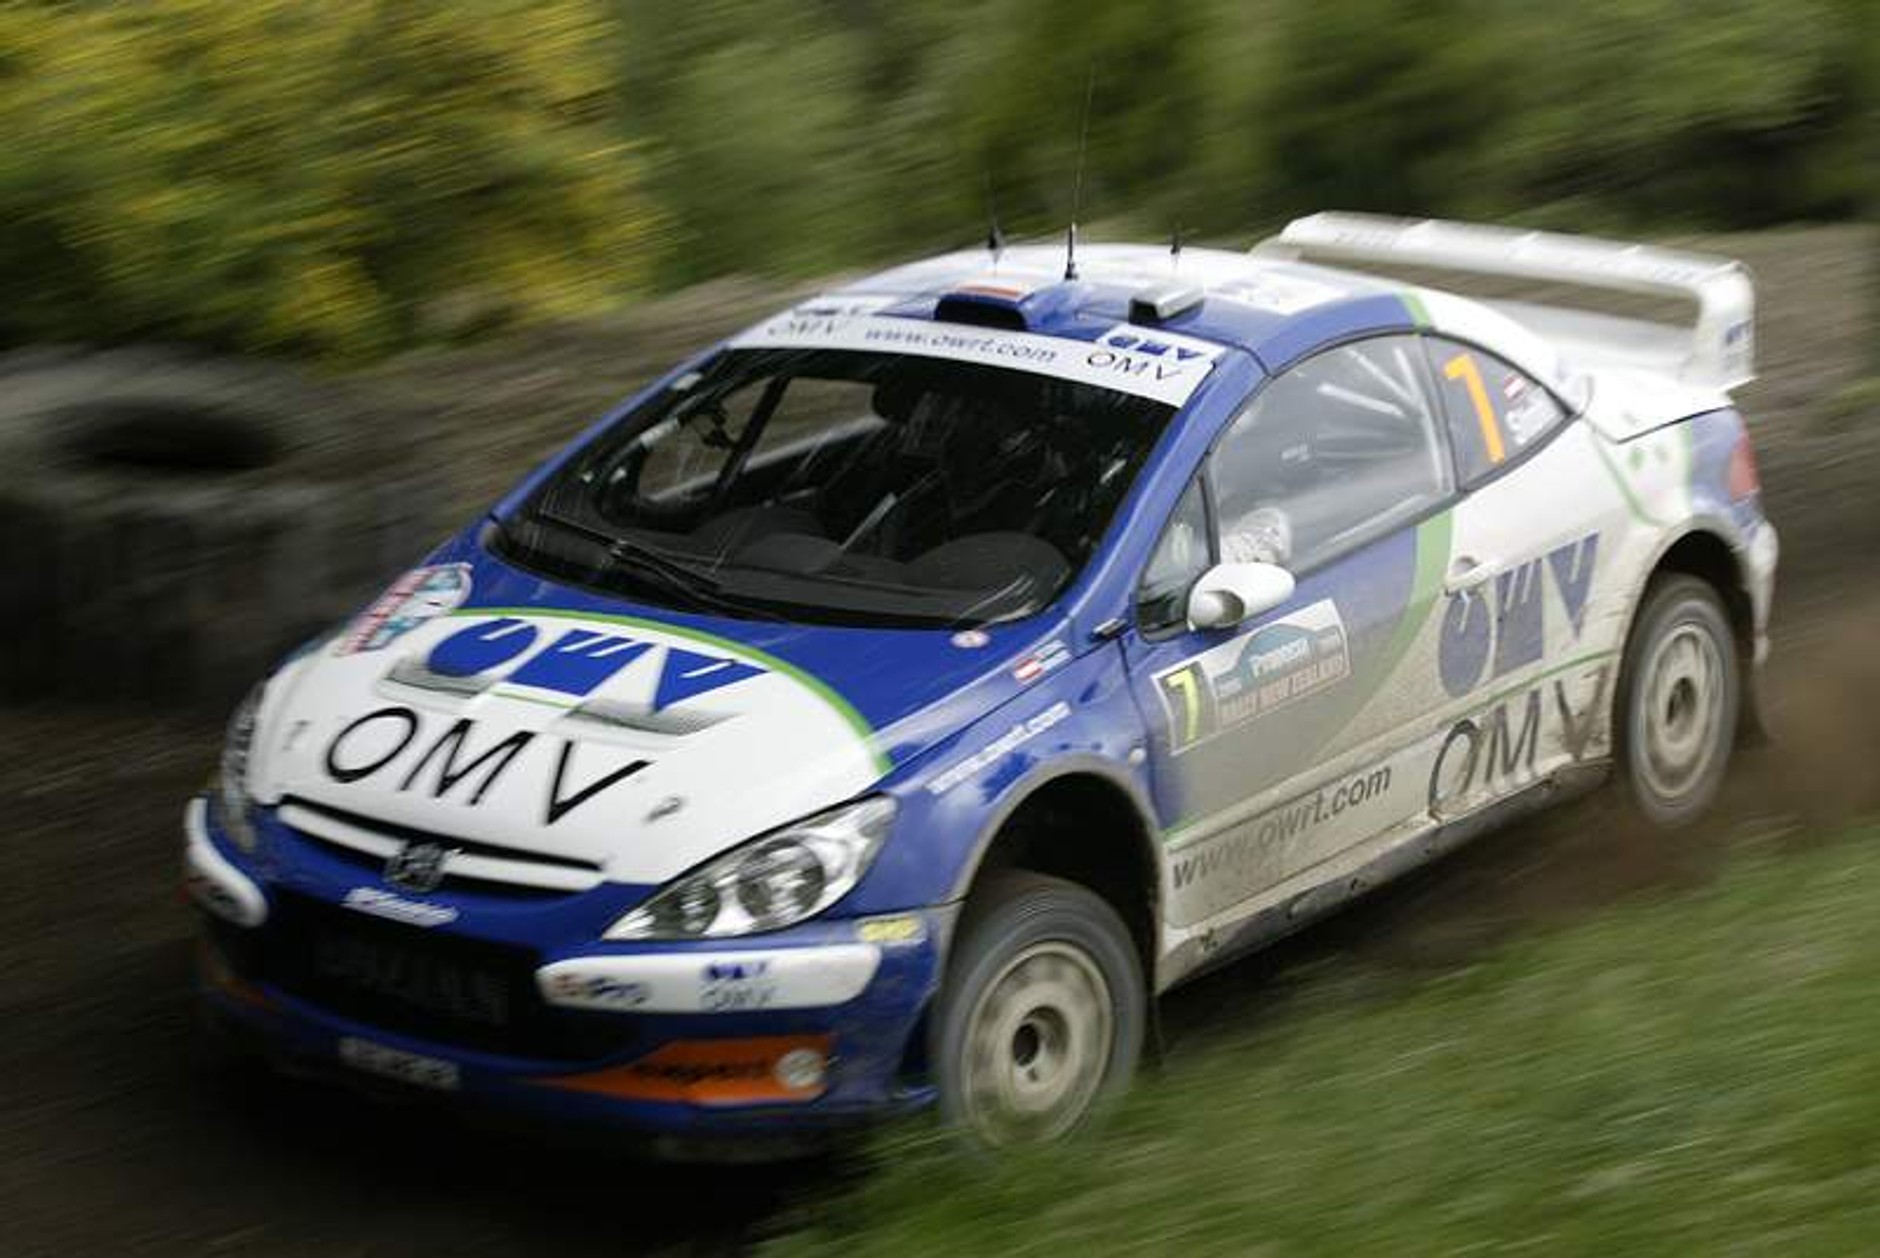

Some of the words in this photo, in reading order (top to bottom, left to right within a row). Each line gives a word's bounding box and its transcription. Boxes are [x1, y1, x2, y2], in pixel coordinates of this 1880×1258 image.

[1087, 352, 1182, 380] OMV
[326, 707, 656, 825] OMV
[1429, 662, 1611, 812] OMV
